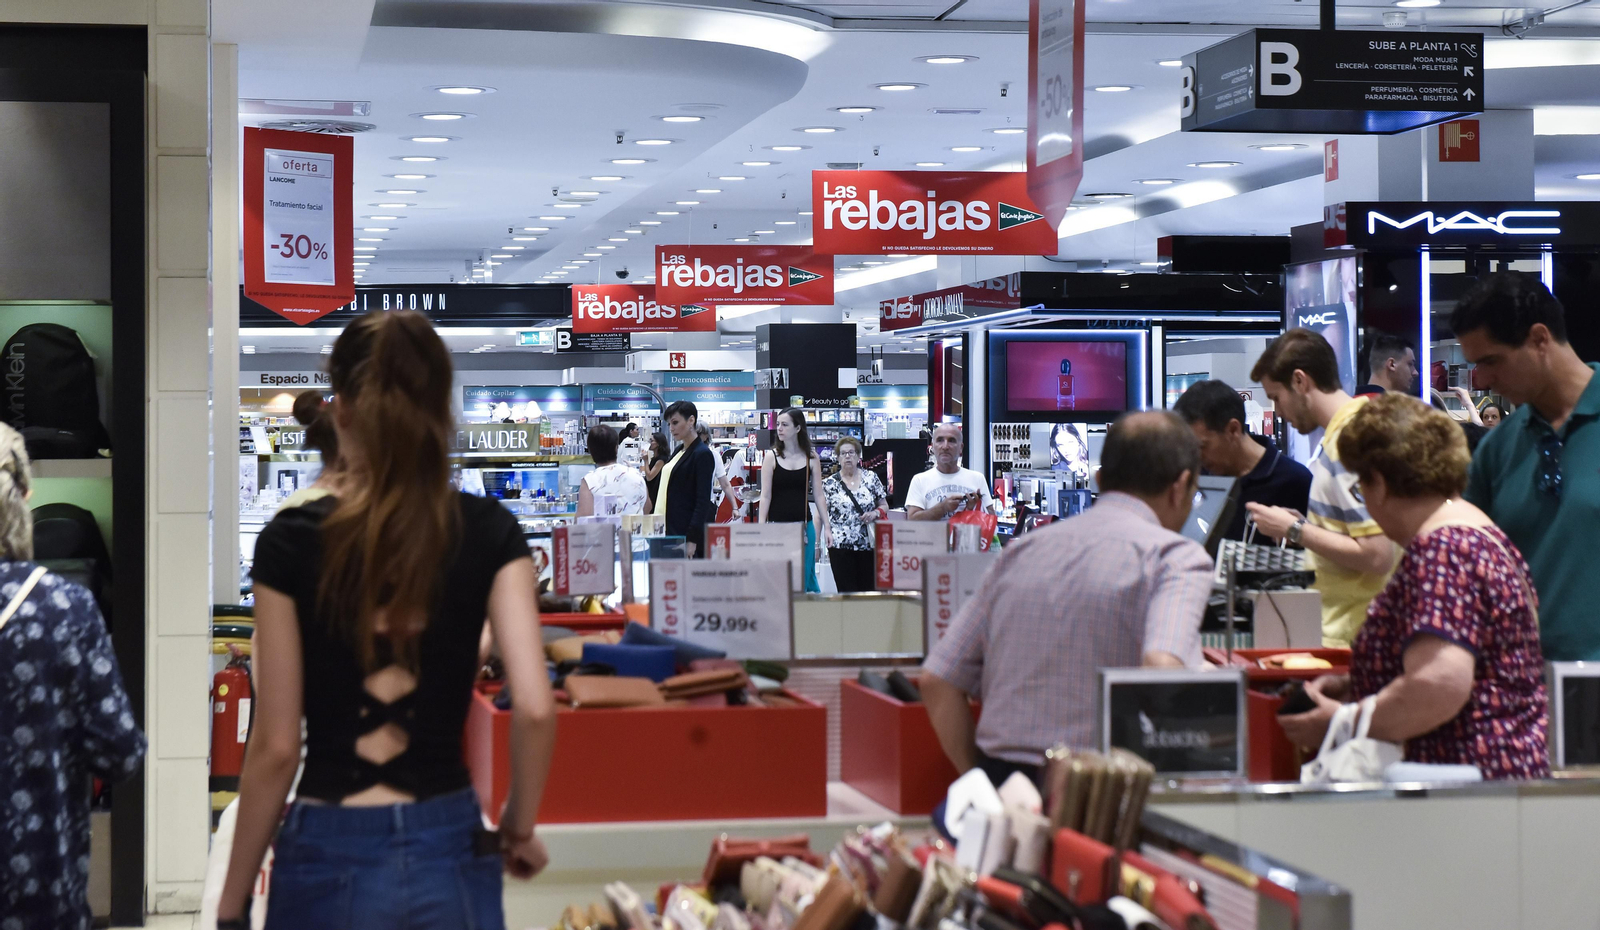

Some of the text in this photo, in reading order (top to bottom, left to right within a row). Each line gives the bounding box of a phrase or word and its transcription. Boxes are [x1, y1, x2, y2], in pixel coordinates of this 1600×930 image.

[1368, 41, 1458, 51] SUBE A PLANTA 1
[1259, 41, 1302, 96] B
[1335, 62, 1370, 70] LENCERÍA
[1181, 66, 1196, 119] B
[1419, 86, 1458, 94] COSMÉTICA
[1423, 94, 1458, 102] BISUTERÍA
[282, 159, 318, 173] oferta
[823, 182, 857, 199] Las
[269, 200, 323, 211] Tratamiento facial
[823, 190, 991, 240] rebajas
[270, 233, 328, 260] -30%
[661, 252, 686, 265] Las
[661, 258, 784, 293] rebajas
[383, 293, 446, 311] BROWN
[578, 291, 598, 302] Las
[578, 295, 677, 324] rebajas
[924, 292, 964, 319] GIORGIO ARMANI
[558, 331, 572, 349] B
[5, 342, 25, 390] Klein
[261, 374, 308, 386] Espacio
[671, 376, 731, 384] Dermocosmética
[626, 388, 651, 396] Capila
[469, 430, 528, 449] LAUDER
[558, 539, 568, 589] rebajas
[880, 534, 890, 582] rebajas
[897, 556, 921, 571] -50
[572, 560, 598, 575] -50%
[694, 613, 757, 633] 29,99€
